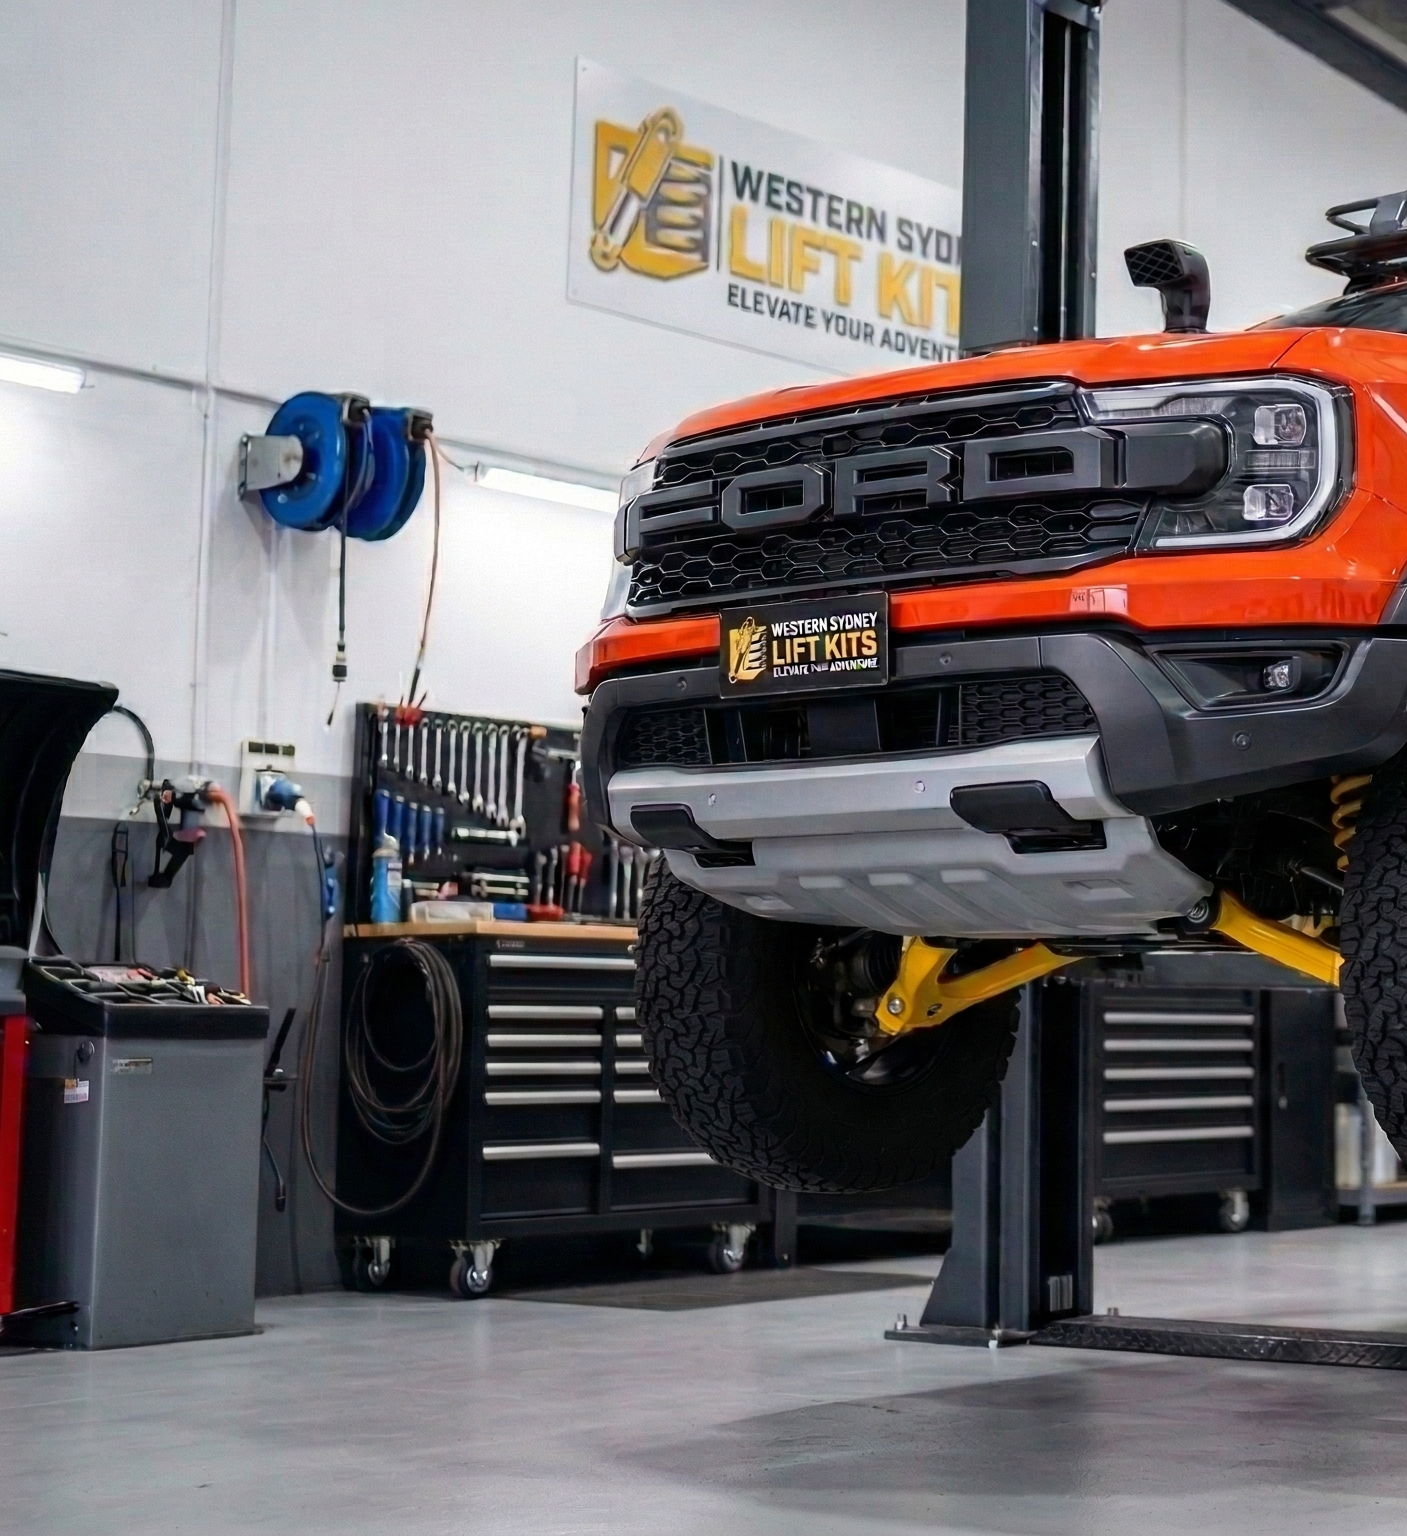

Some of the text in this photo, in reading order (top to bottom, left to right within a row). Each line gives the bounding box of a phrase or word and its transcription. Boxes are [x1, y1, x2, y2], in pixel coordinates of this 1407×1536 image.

[731, 160, 961, 267] WESTERN SYD
[729, 204, 863, 308] LIFT
[727, 283, 816, 329] ELEVATE
[821, 309, 875, 346] YOUR
[615, 427, 1128, 564] FORD
[771, 611, 878, 637] WESTERN SYDNEY
[772, 629, 878, 666] LIFT KITS
